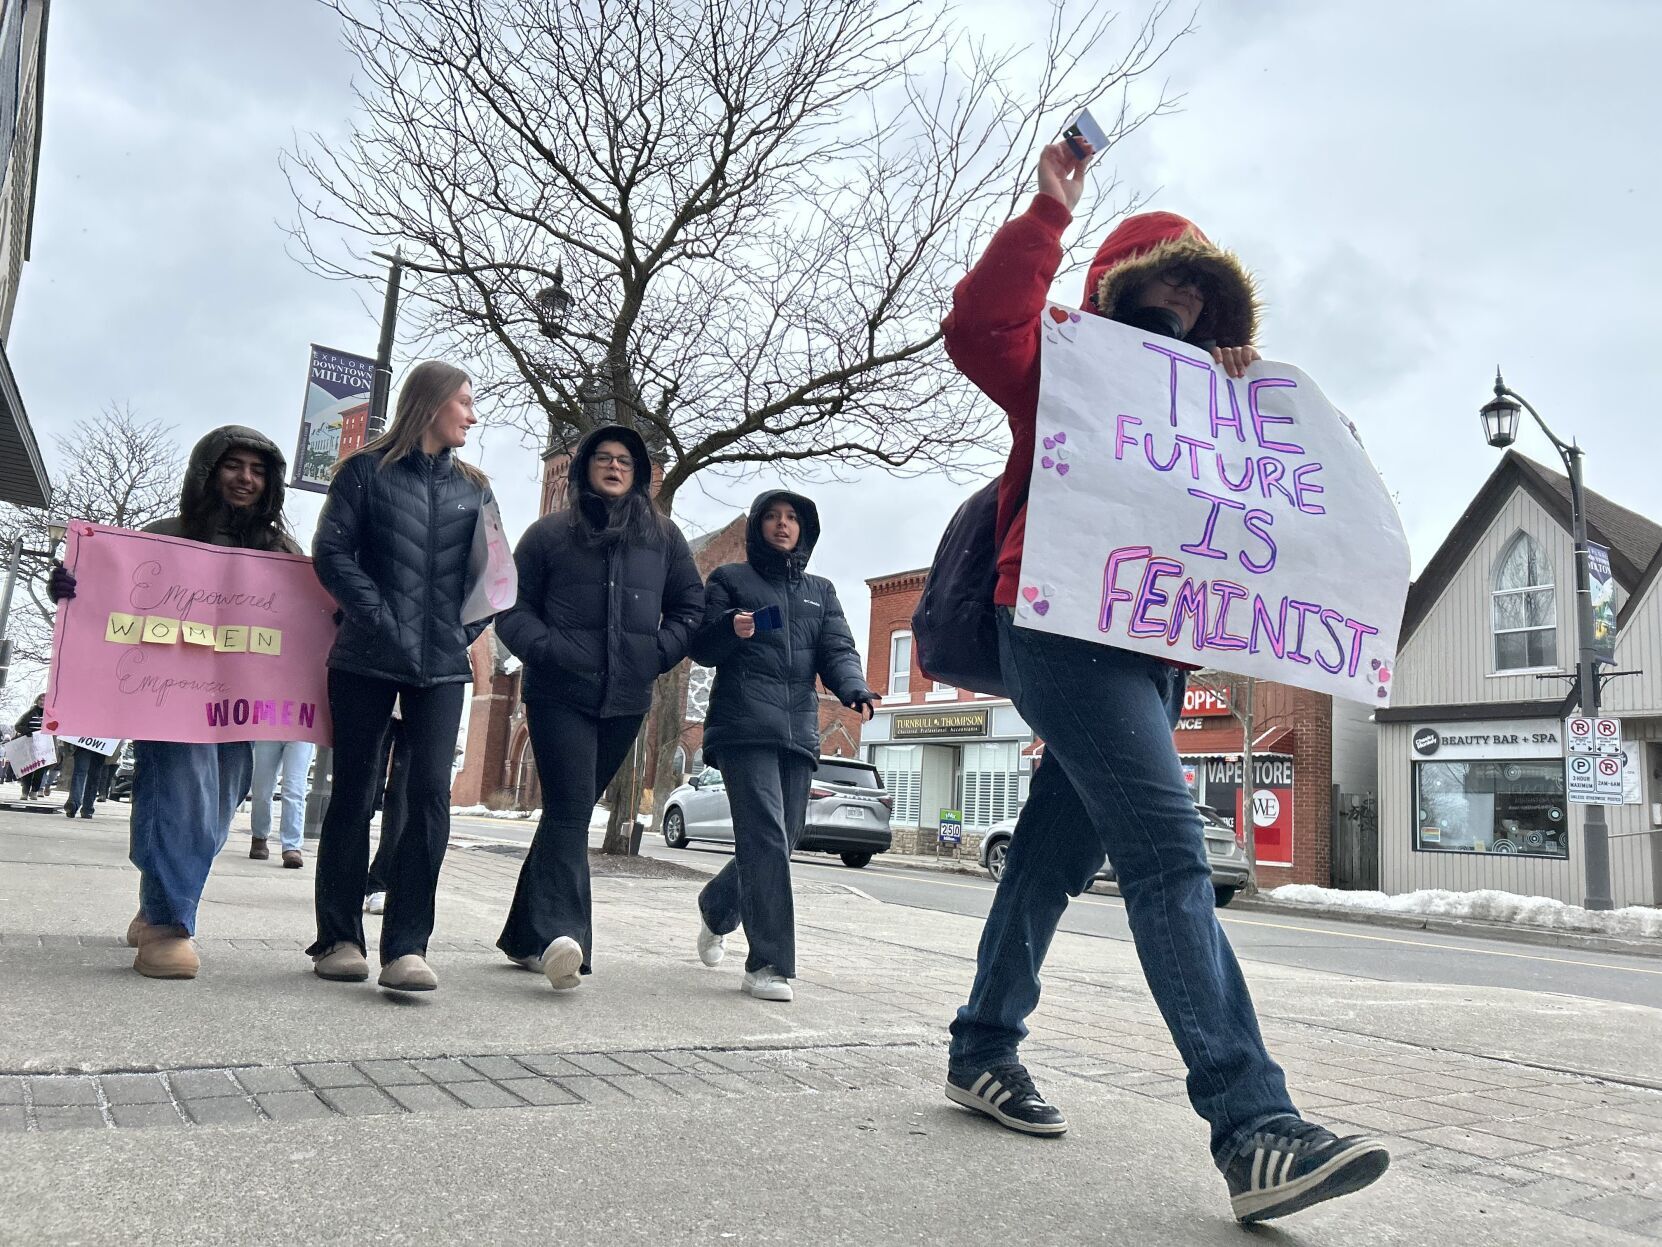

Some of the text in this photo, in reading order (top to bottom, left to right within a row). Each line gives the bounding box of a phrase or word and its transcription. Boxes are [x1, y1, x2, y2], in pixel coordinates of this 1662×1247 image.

[312, 359, 372, 380] DOWNTOWN
[314, 352, 374, 372] EXPLORE
[312, 368, 372, 390] MILTON
[1142, 341, 1305, 454] THE
[1115, 414, 1326, 515] FUTURE
[1180, 488, 1278, 574] IS
[130, 560, 279, 619] Empowered
[1098, 546, 1379, 678] FEMINIST
[111, 618, 272, 648] WOMEN
[206, 698, 316, 728] WOMEN
[896, 718, 931, 728] TURNBULL
[940, 716, 983, 727] THOMPSON
[78, 736, 106, 750] NOW!
[1441, 736, 1490, 746] BEAUTY
[1493, 734, 1518, 744] BAR
[1532, 734, 1558, 743] SPA
[1208, 762, 1242, 784] VAPE
[1252, 762, 1292, 784] TORE
